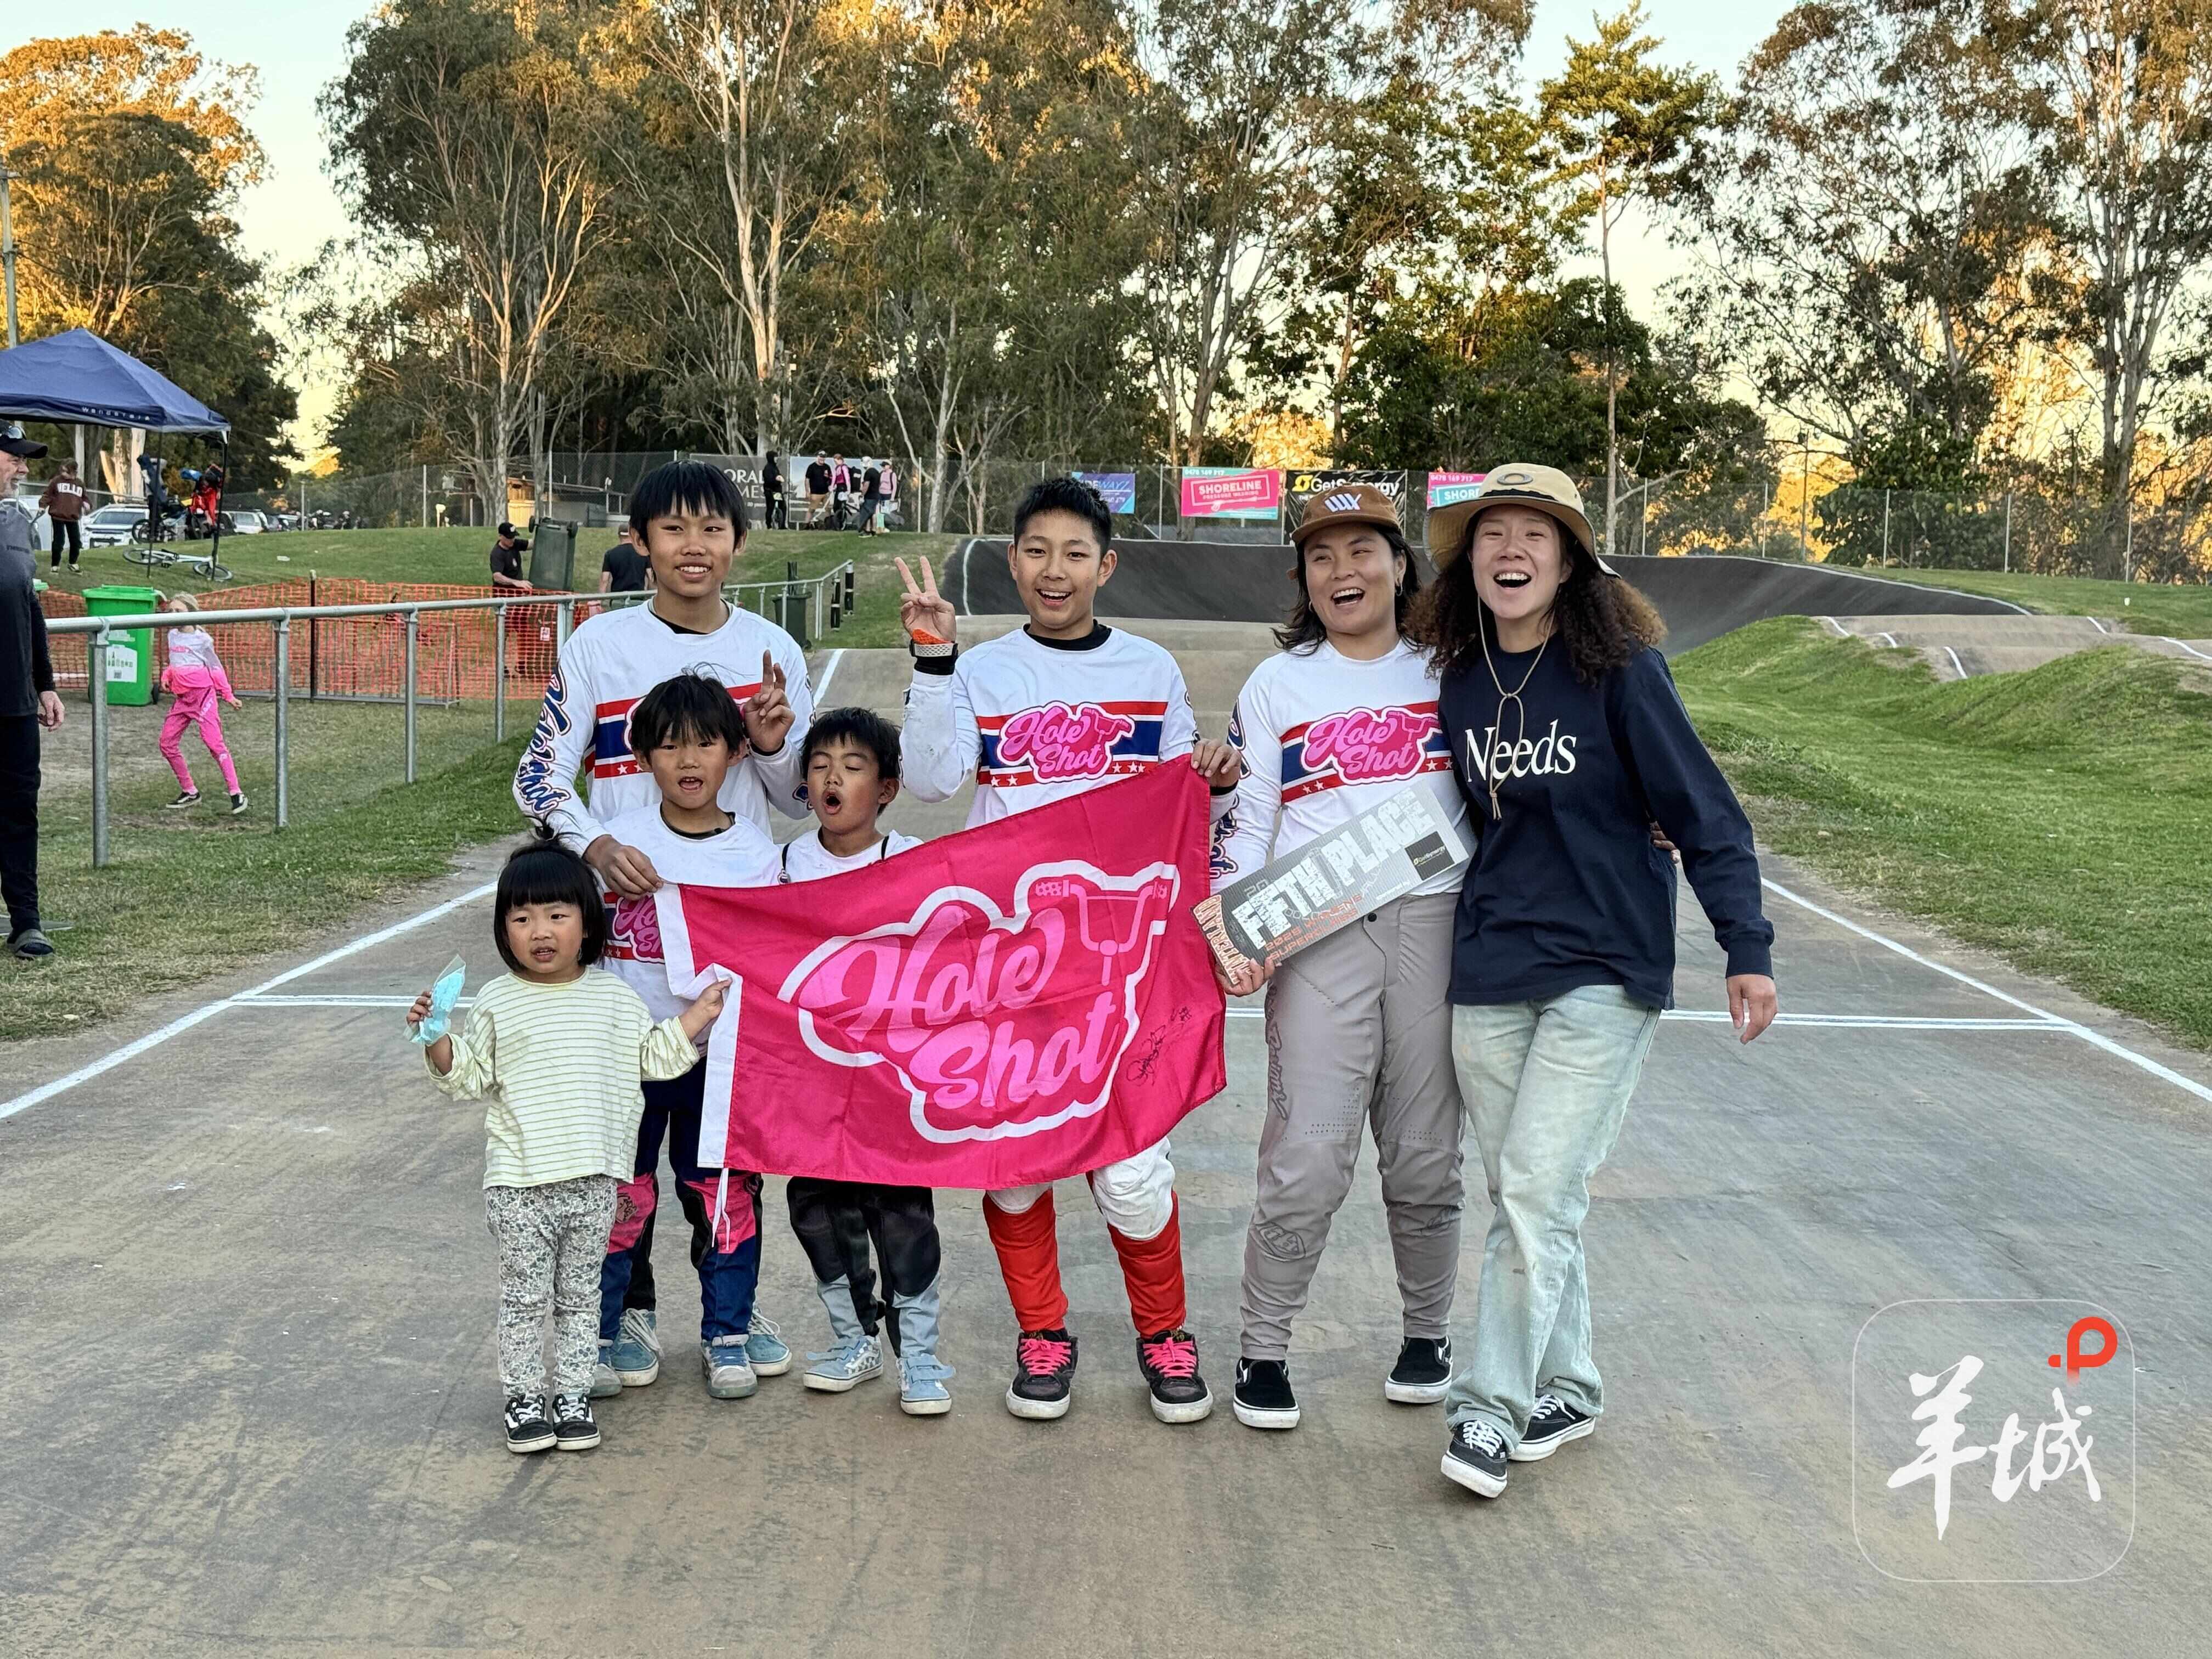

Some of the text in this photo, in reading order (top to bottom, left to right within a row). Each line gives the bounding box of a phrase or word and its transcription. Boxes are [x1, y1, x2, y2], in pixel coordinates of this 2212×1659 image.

[724, 468, 764, 483] ORAL
[1198, 480, 1262, 495] SHORELINE
[1002, 706, 1091, 758] Hole
[1034, 742, 1105, 775] Shot
[1305, 712, 1395, 766] Hole
[1465, 719, 1577, 782] Needs
[1338, 741, 1415, 777] Shot
[1231, 787, 1436, 950] FIFTH PLACE
[797, 904, 1066, 1053] Hole
[910, 991, 1121, 1109] Shot
